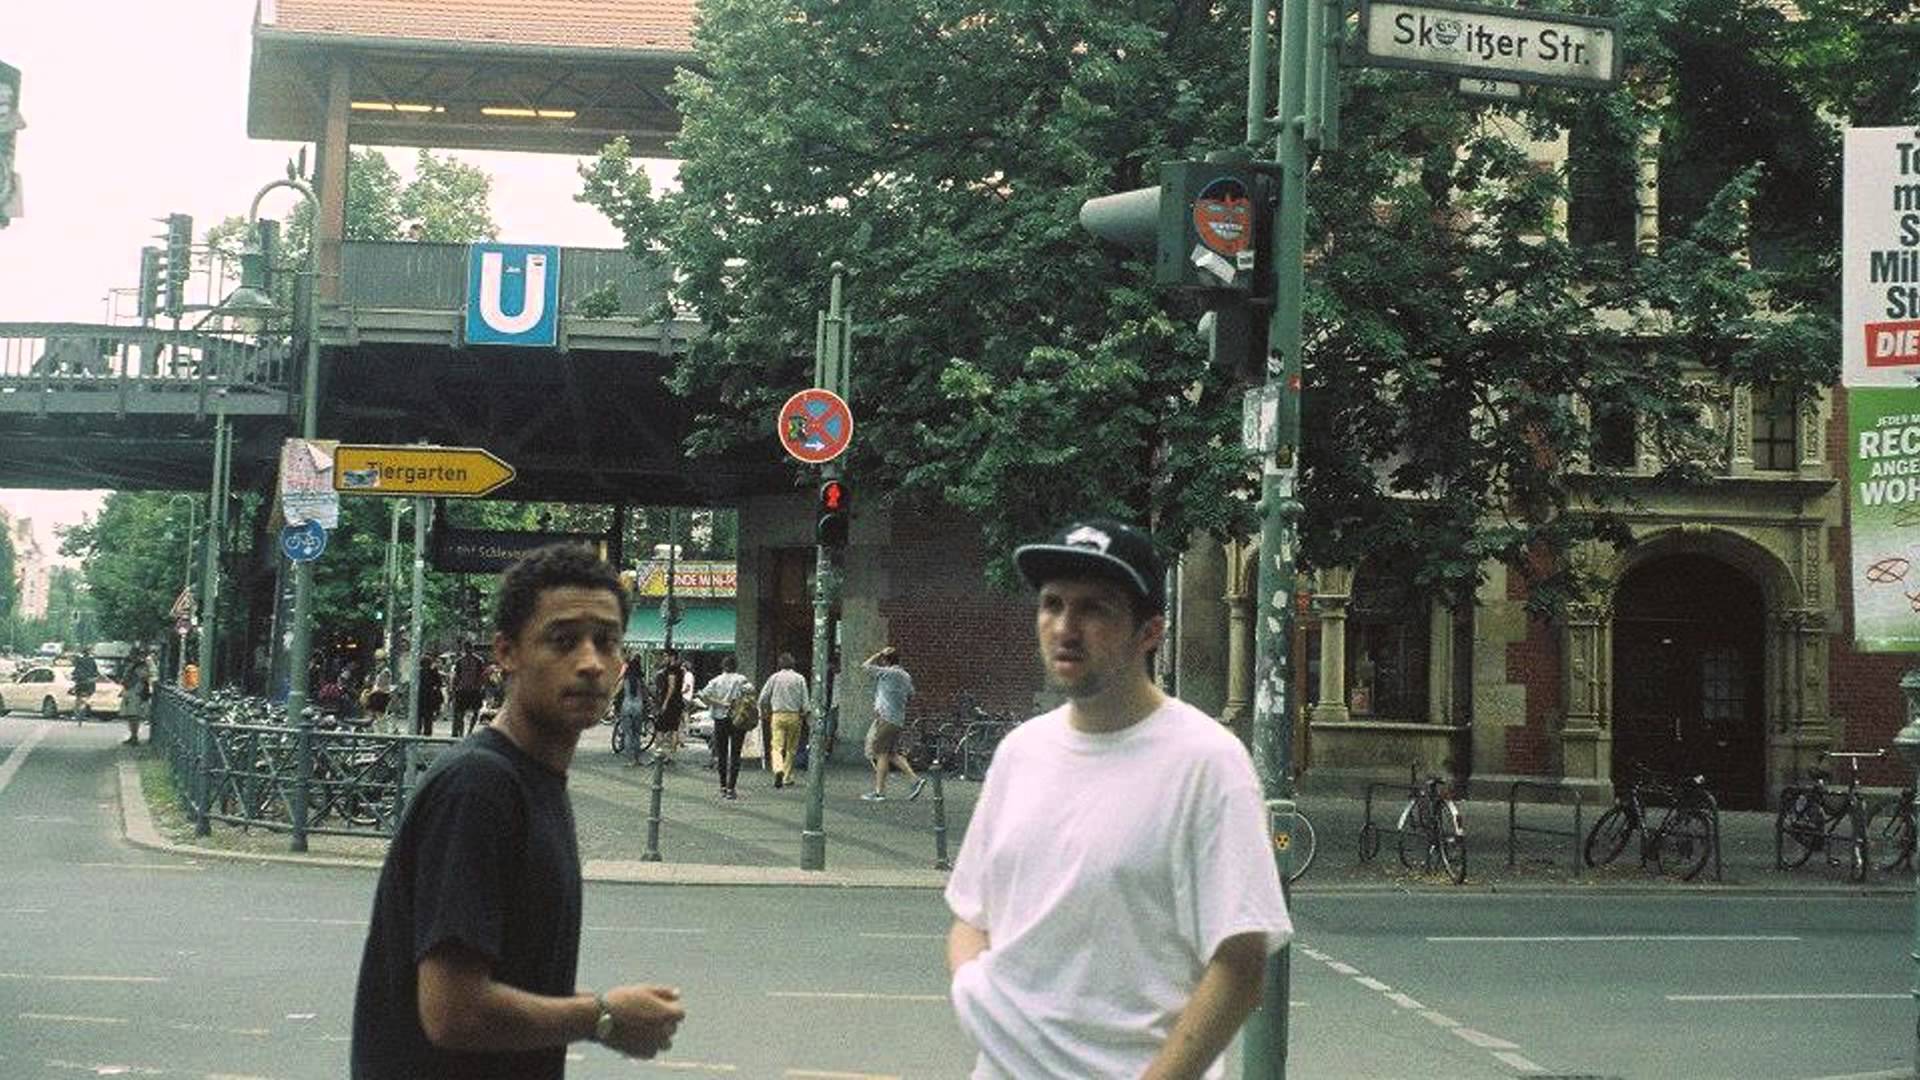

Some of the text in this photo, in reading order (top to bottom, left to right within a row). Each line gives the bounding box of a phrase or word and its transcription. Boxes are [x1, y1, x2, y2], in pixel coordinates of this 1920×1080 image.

[1538, 29, 1590, 65] Str.
[480, 252, 547, 334] U
[1886, 286, 1920, 319] St
[1875, 329, 1920, 358] DIE
[1859, 426, 1920, 459] REC
[1871, 458, 1920, 478] ANGE
